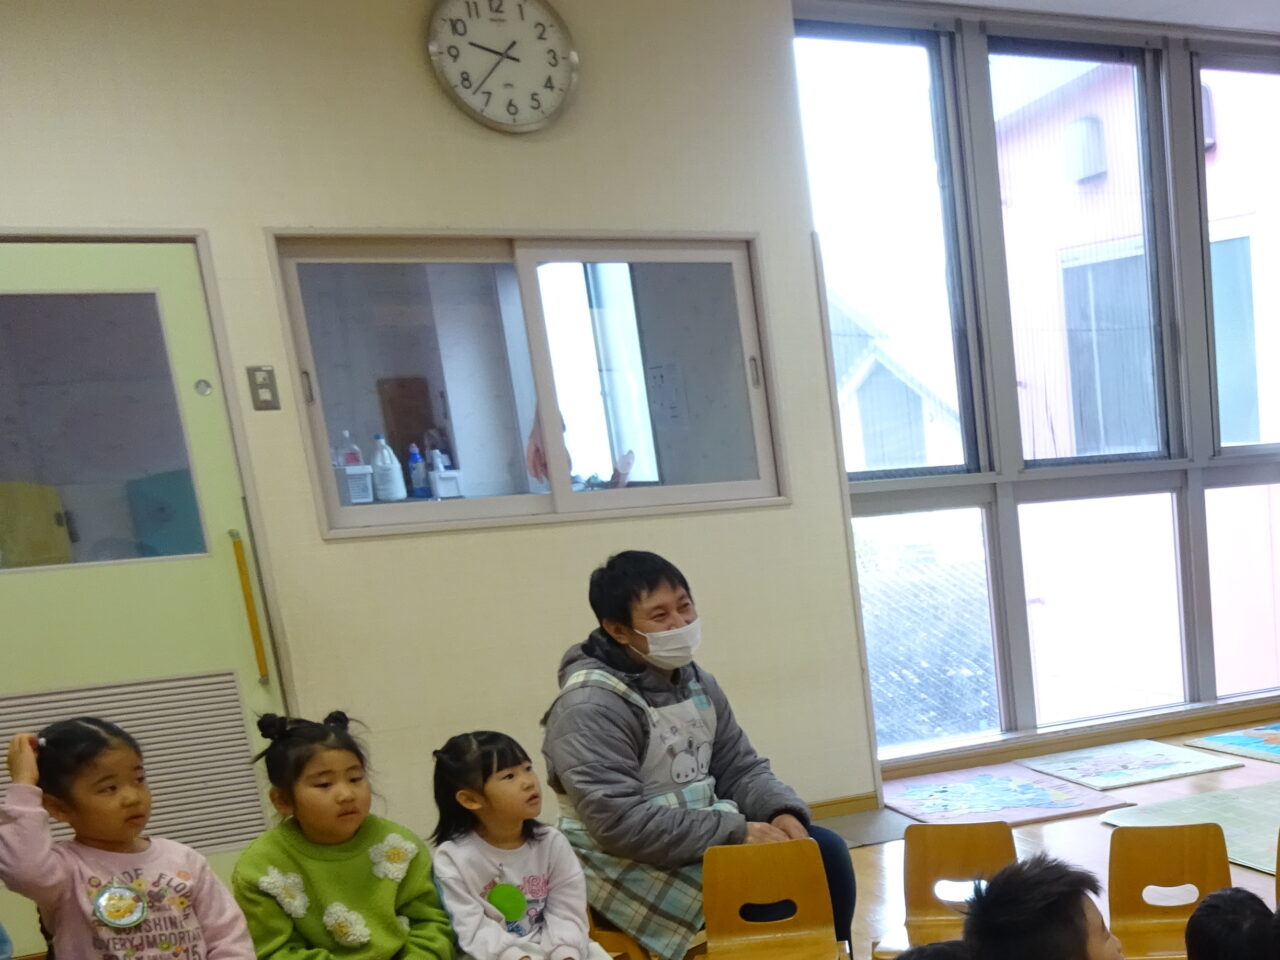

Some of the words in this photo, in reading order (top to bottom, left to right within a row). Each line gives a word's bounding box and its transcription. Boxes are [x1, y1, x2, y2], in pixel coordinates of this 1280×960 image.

[466, 1, 480, 19] 11
[489, 0, 504, 13] 12
[517, 4, 525, 21] 1
[450, 18, 467, 36] 10
[534, 22, 547, 40] 2
[447, 45, 460, 63] 9
[547, 49, 559, 67] 3
[460, 71, 472, 89] 8
[544, 75, 555, 91] 4
[482, 91, 492, 107] 7
[506, 99, 518, 116] 6
[530, 93, 541, 110] 5
